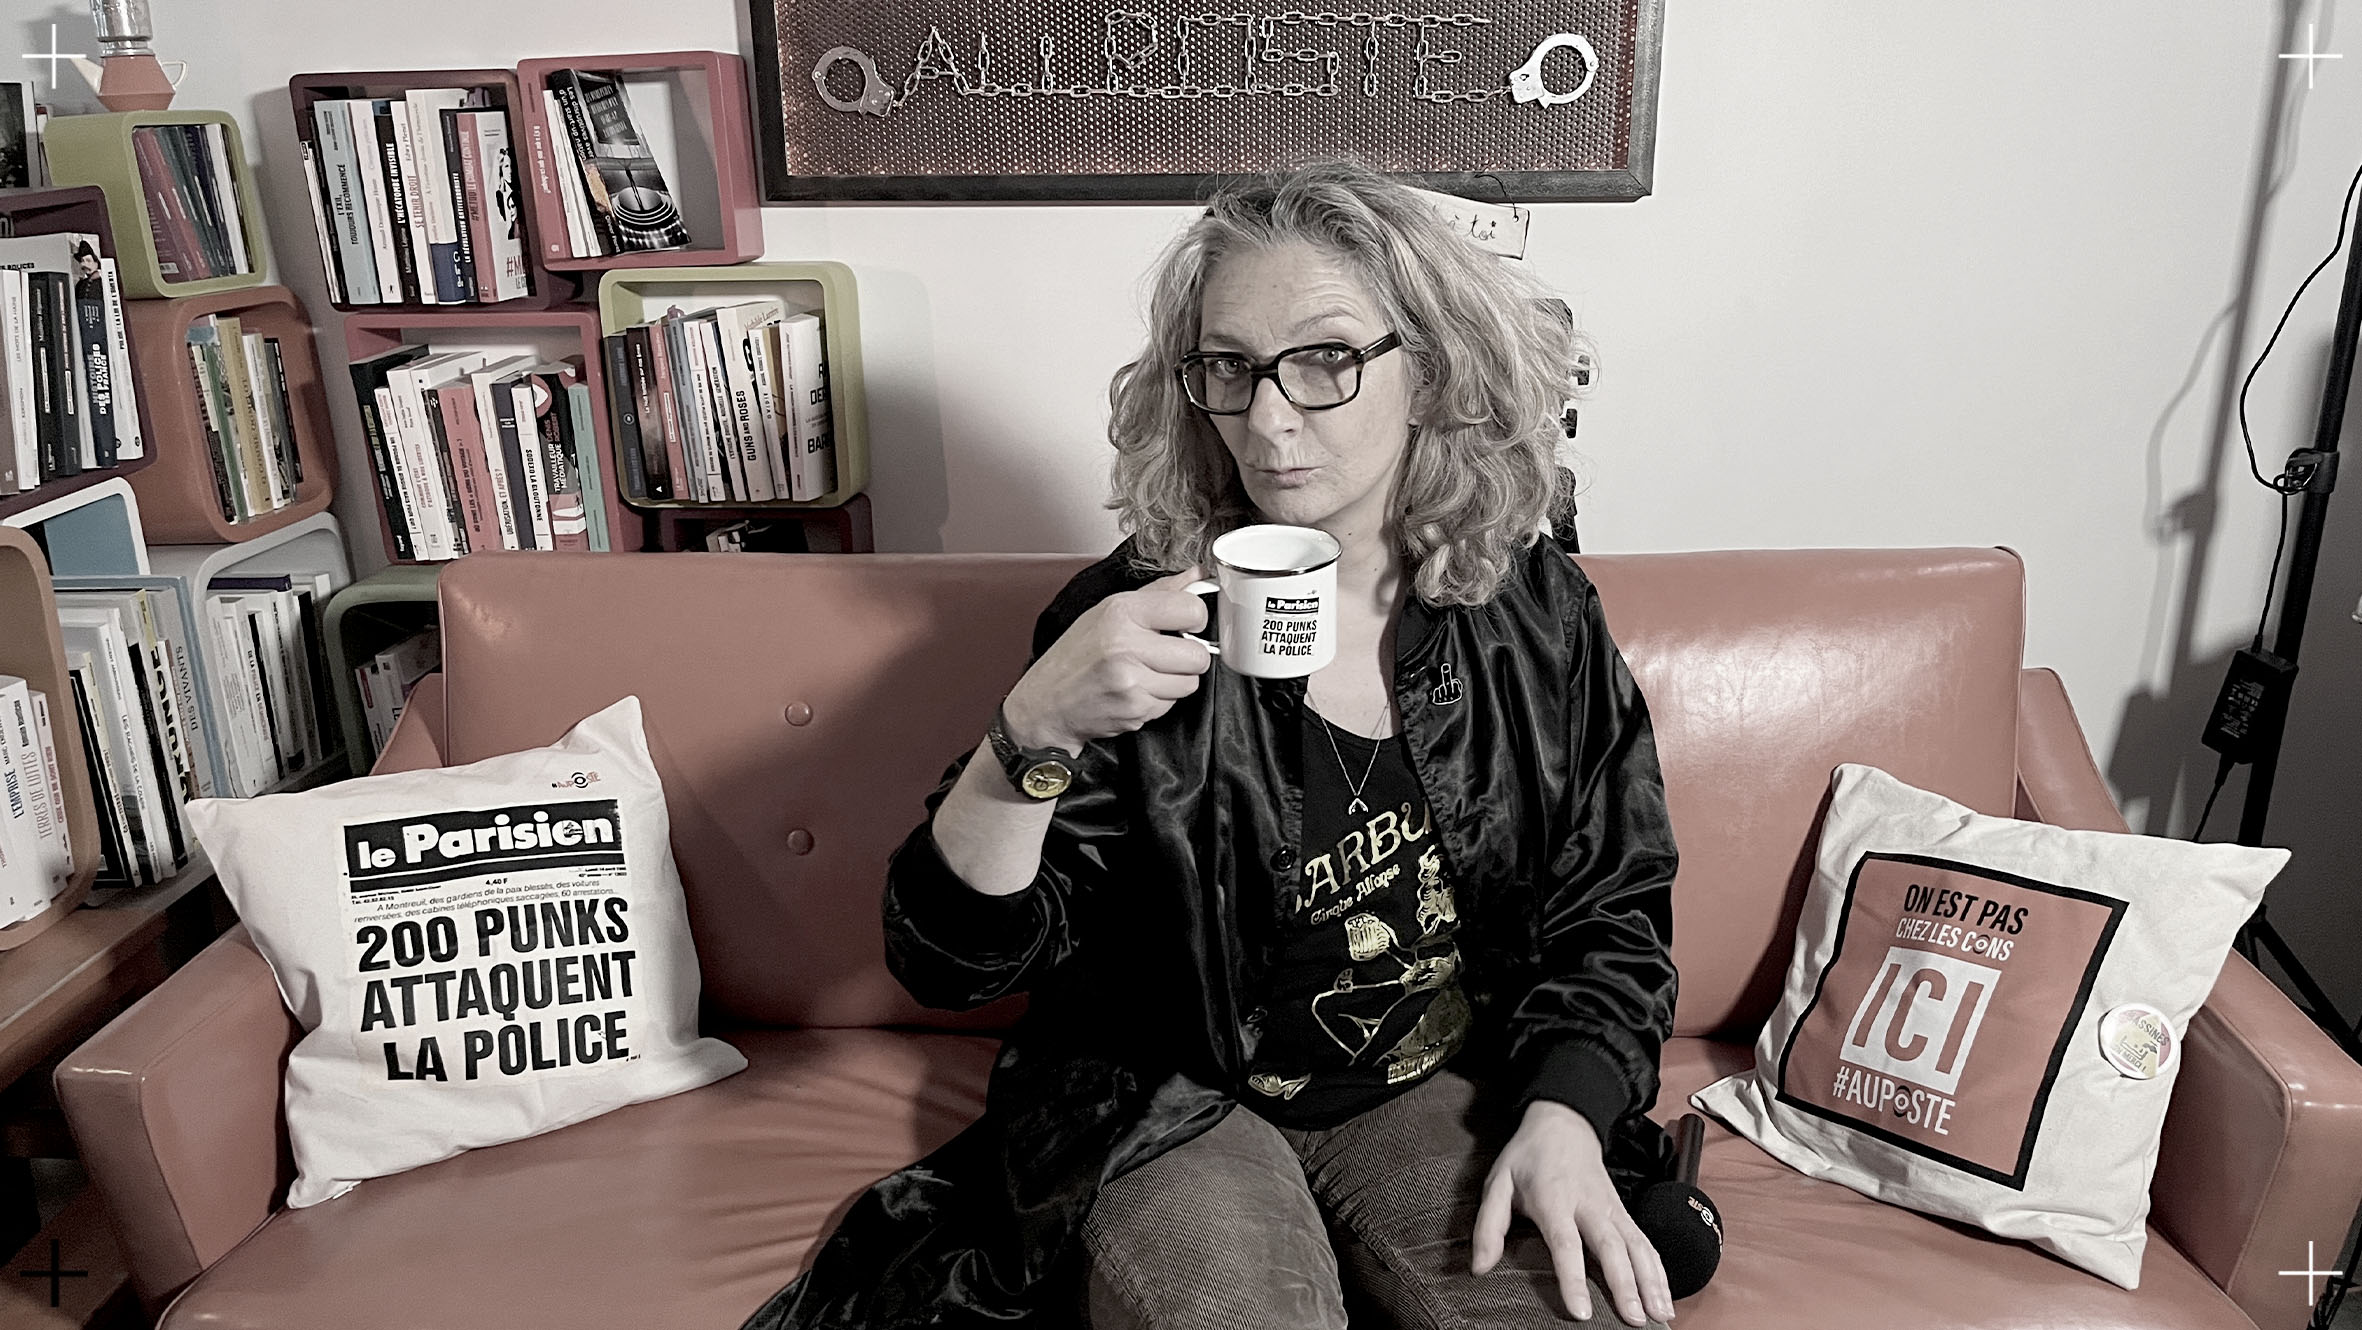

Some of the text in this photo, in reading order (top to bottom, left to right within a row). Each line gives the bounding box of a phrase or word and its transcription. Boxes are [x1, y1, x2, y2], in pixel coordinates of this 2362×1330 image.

[566, 86, 576, 100] Les
[385, 142, 398, 177] INVISIBLE
[336, 163, 359, 245] TOUJOURS RECOMMENCÉ
[390, 178, 406, 224] L'HÉCATOMBE
[407, 174, 423, 228] SE TENIR DROIT
[466, 182, 475, 190] LE
[468, 191, 480, 222] #METOO
[452, 172, 471, 263] LA RÉVOLUTION ANTITERRORISTE
[115, 318, 121, 326] LA
[86, 353, 99, 404] HISTOIRE
[92, 343, 107, 414] DES POLICES
[100, 354, 111, 404] EN FRANCE
[735, 390, 757, 462] GUNS AND ROSES
[544, 419, 561, 492] TRAVAILLEUR DENIS
[550, 412, 568, 489] MÉDIATIQUE ROBERT
[402, 491, 411, 504] MAIS
[495, 473, 506, 490] APRÈS
[525, 449, 543, 521] SODEXO LA GLOUTONNE
[406, 504, 414, 517] POUR
[1262, 619, 1317, 632] 200 PUNKS
[1277, 600, 1319, 610] Parisien
[1261, 631, 1317, 645] ATTAQUENT
[1264, 643, 1312, 656] LA POLICE
[175, 645, 191, 703] VIVANTS
[247, 650, 270, 741] DE LA POLICE EN DÉMOCRATIE
[121, 713, 131, 731] LES
[186, 706, 199, 731] DES
[124, 731, 137, 761] RACINES
[21, 750, 42, 787] LUTTES
[130, 762, 140, 774] DE
[3, 767, 26, 819] L'EMPRISE
[30, 788, 45, 802] DE
[135, 784, 148, 811] COLÈRE
[33, 801, 53, 839] TERRES
[358, 811, 614, 869] le Parisien
[429, 897, 445, 905] des
[445, 889, 483, 904] gardiens
[484, 888, 496, 896] de
[496, 887, 504, 895] la
[505, 886, 522, 895] paix
[524, 882, 554, 893] blessés,
[572, 879, 600, 888] voitures
[485, 878, 502, 886] 4,40
[1311, 863, 1401, 925] Cirque Alfonse
[405, 908, 421, 917] des
[422, 903, 455, 915] cabines
[456, 894, 515, 912] téléphoniques
[515, 890, 560, 903] saccagées,
[561, 889, 571, 898] 60
[1903, 884, 2029, 935] ON EST PAS
[356, 897, 629, 972] 200 PUNKS
[1895, 917, 2015, 962] CHEZ LES CONS
[360, 950, 636, 1032] ATTAQUENT
[1852, 962, 1985, 1076] ICI
[383, 1010, 629, 1081] LA POLICE
[1832, 1066, 1956, 1136] #AUPOSTE
